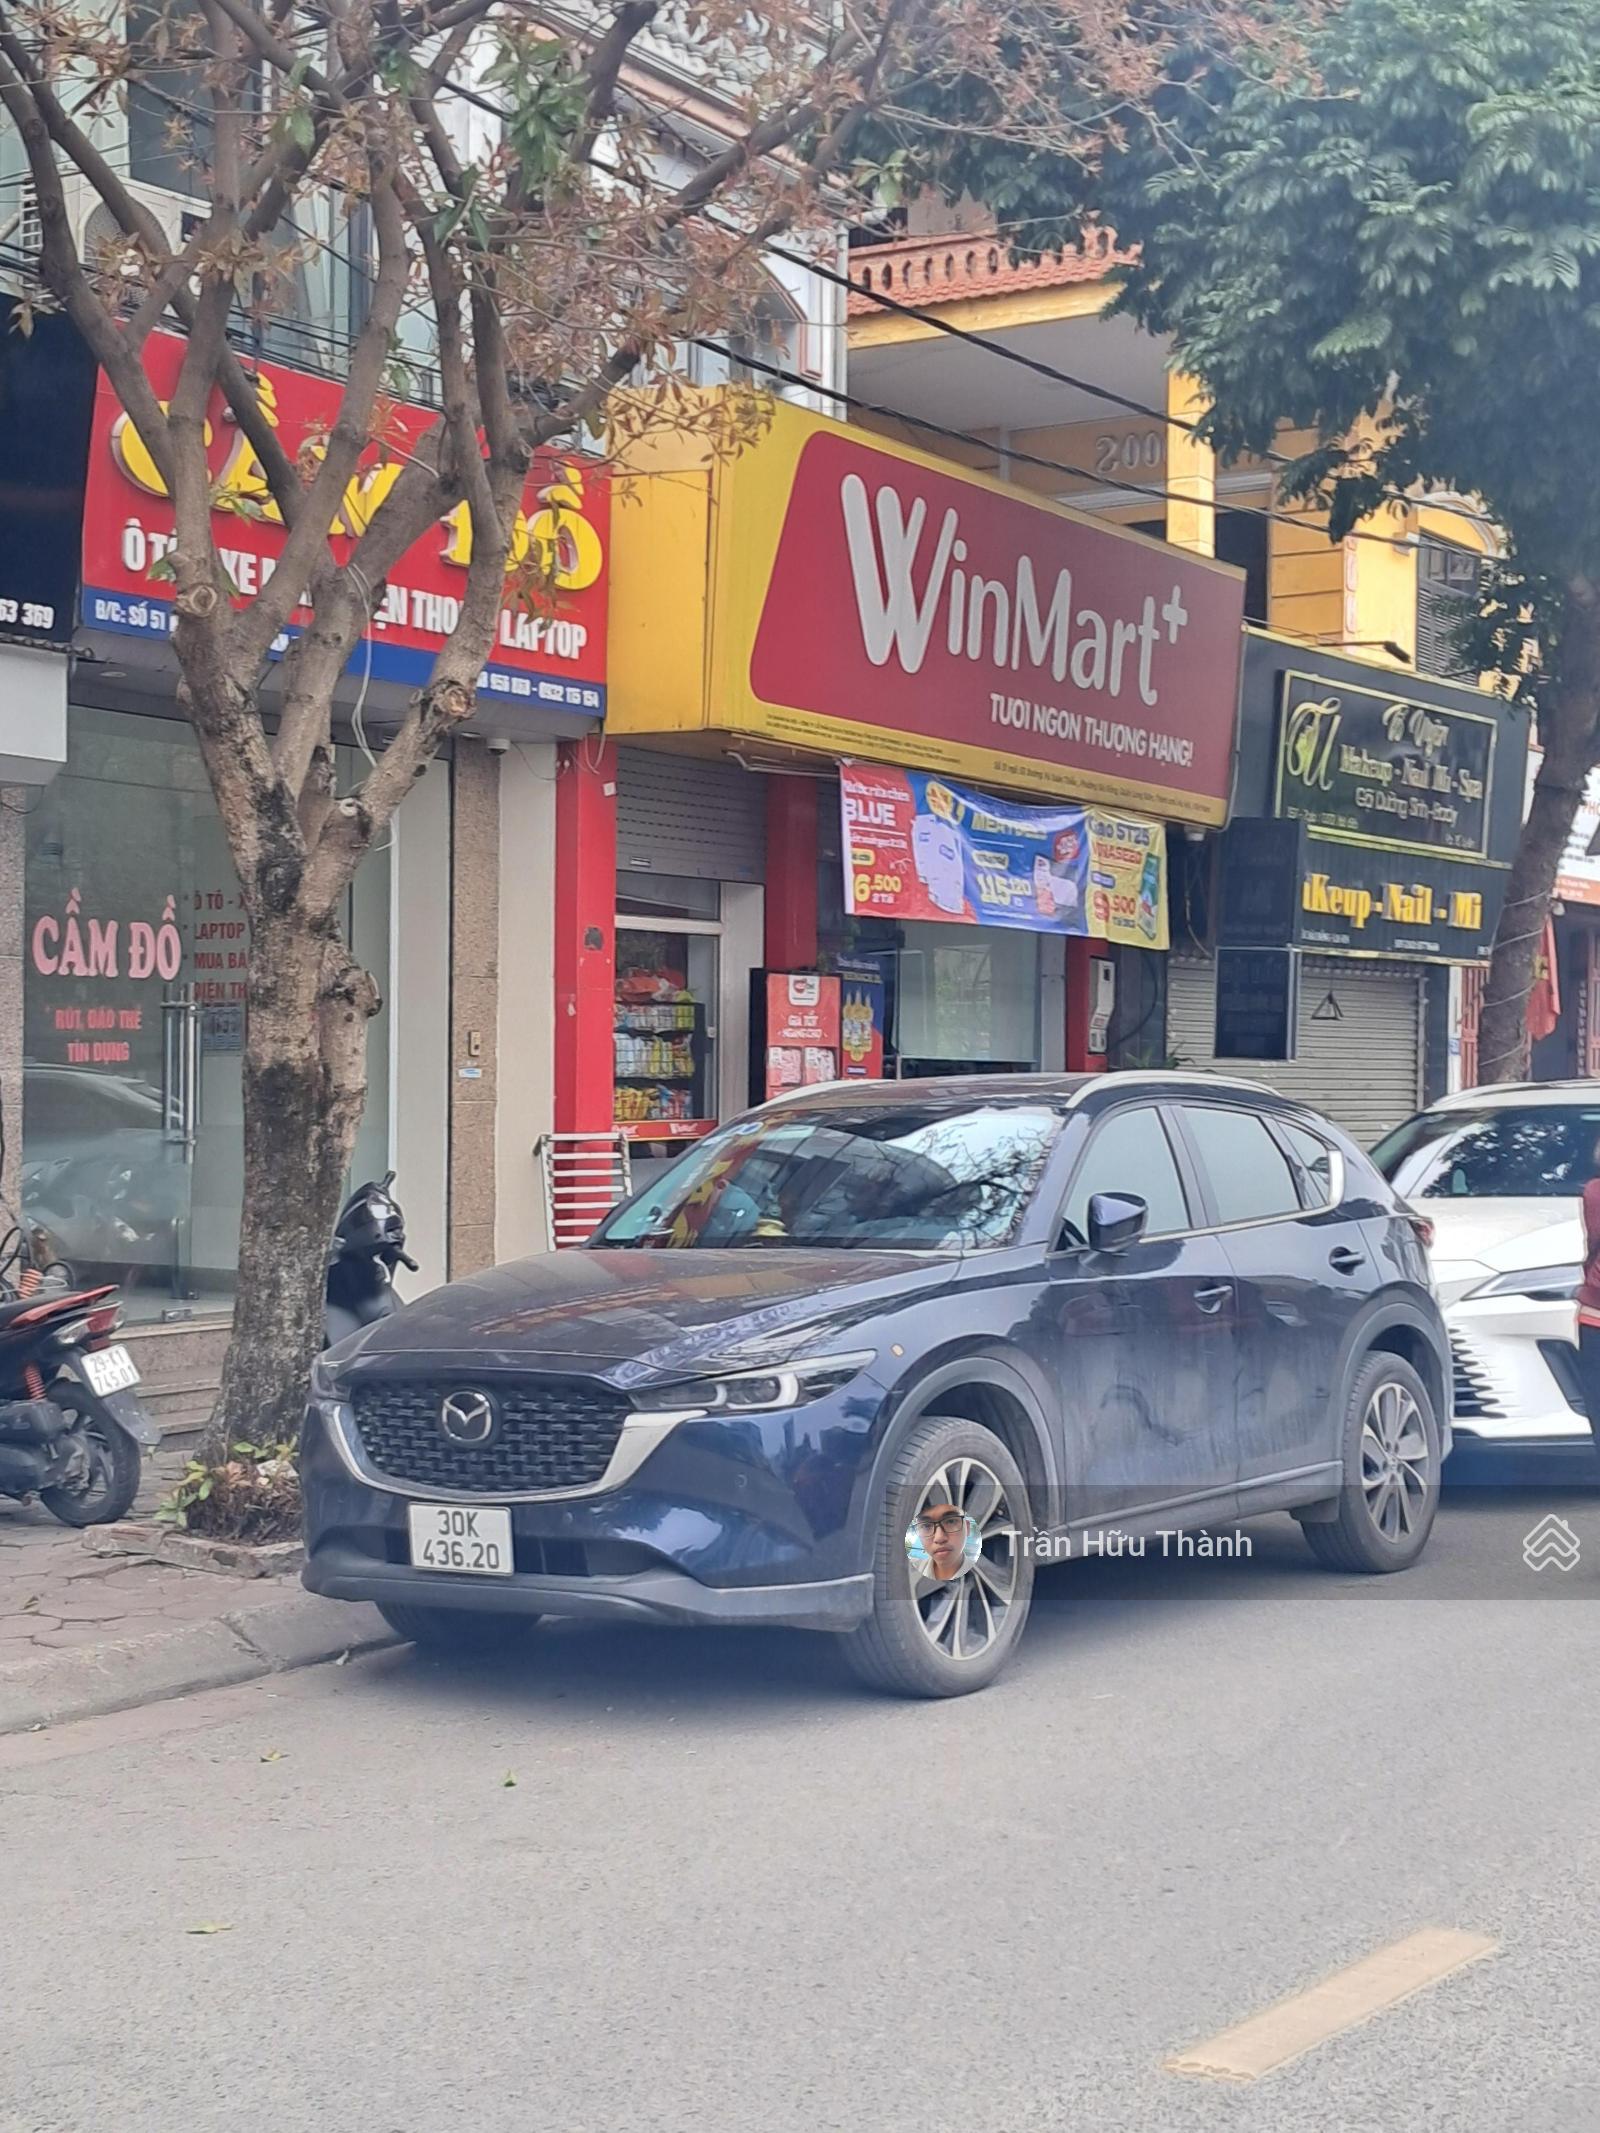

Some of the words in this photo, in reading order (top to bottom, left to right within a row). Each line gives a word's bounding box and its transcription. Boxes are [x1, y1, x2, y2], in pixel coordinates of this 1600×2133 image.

[1033, 703, 1082, 742] NGON
[843, 798, 897, 827] BLUE
[32, 887, 119, 977] CẦM
[128, 894, 182, 981] ĐỒ
[194, 922, 246, 941] LAPTOP
[227, 948, 249, 970] BÁ
[437, 1509, 481, 1538] 30K
[423, 1539, 500, 1569] 436.20
